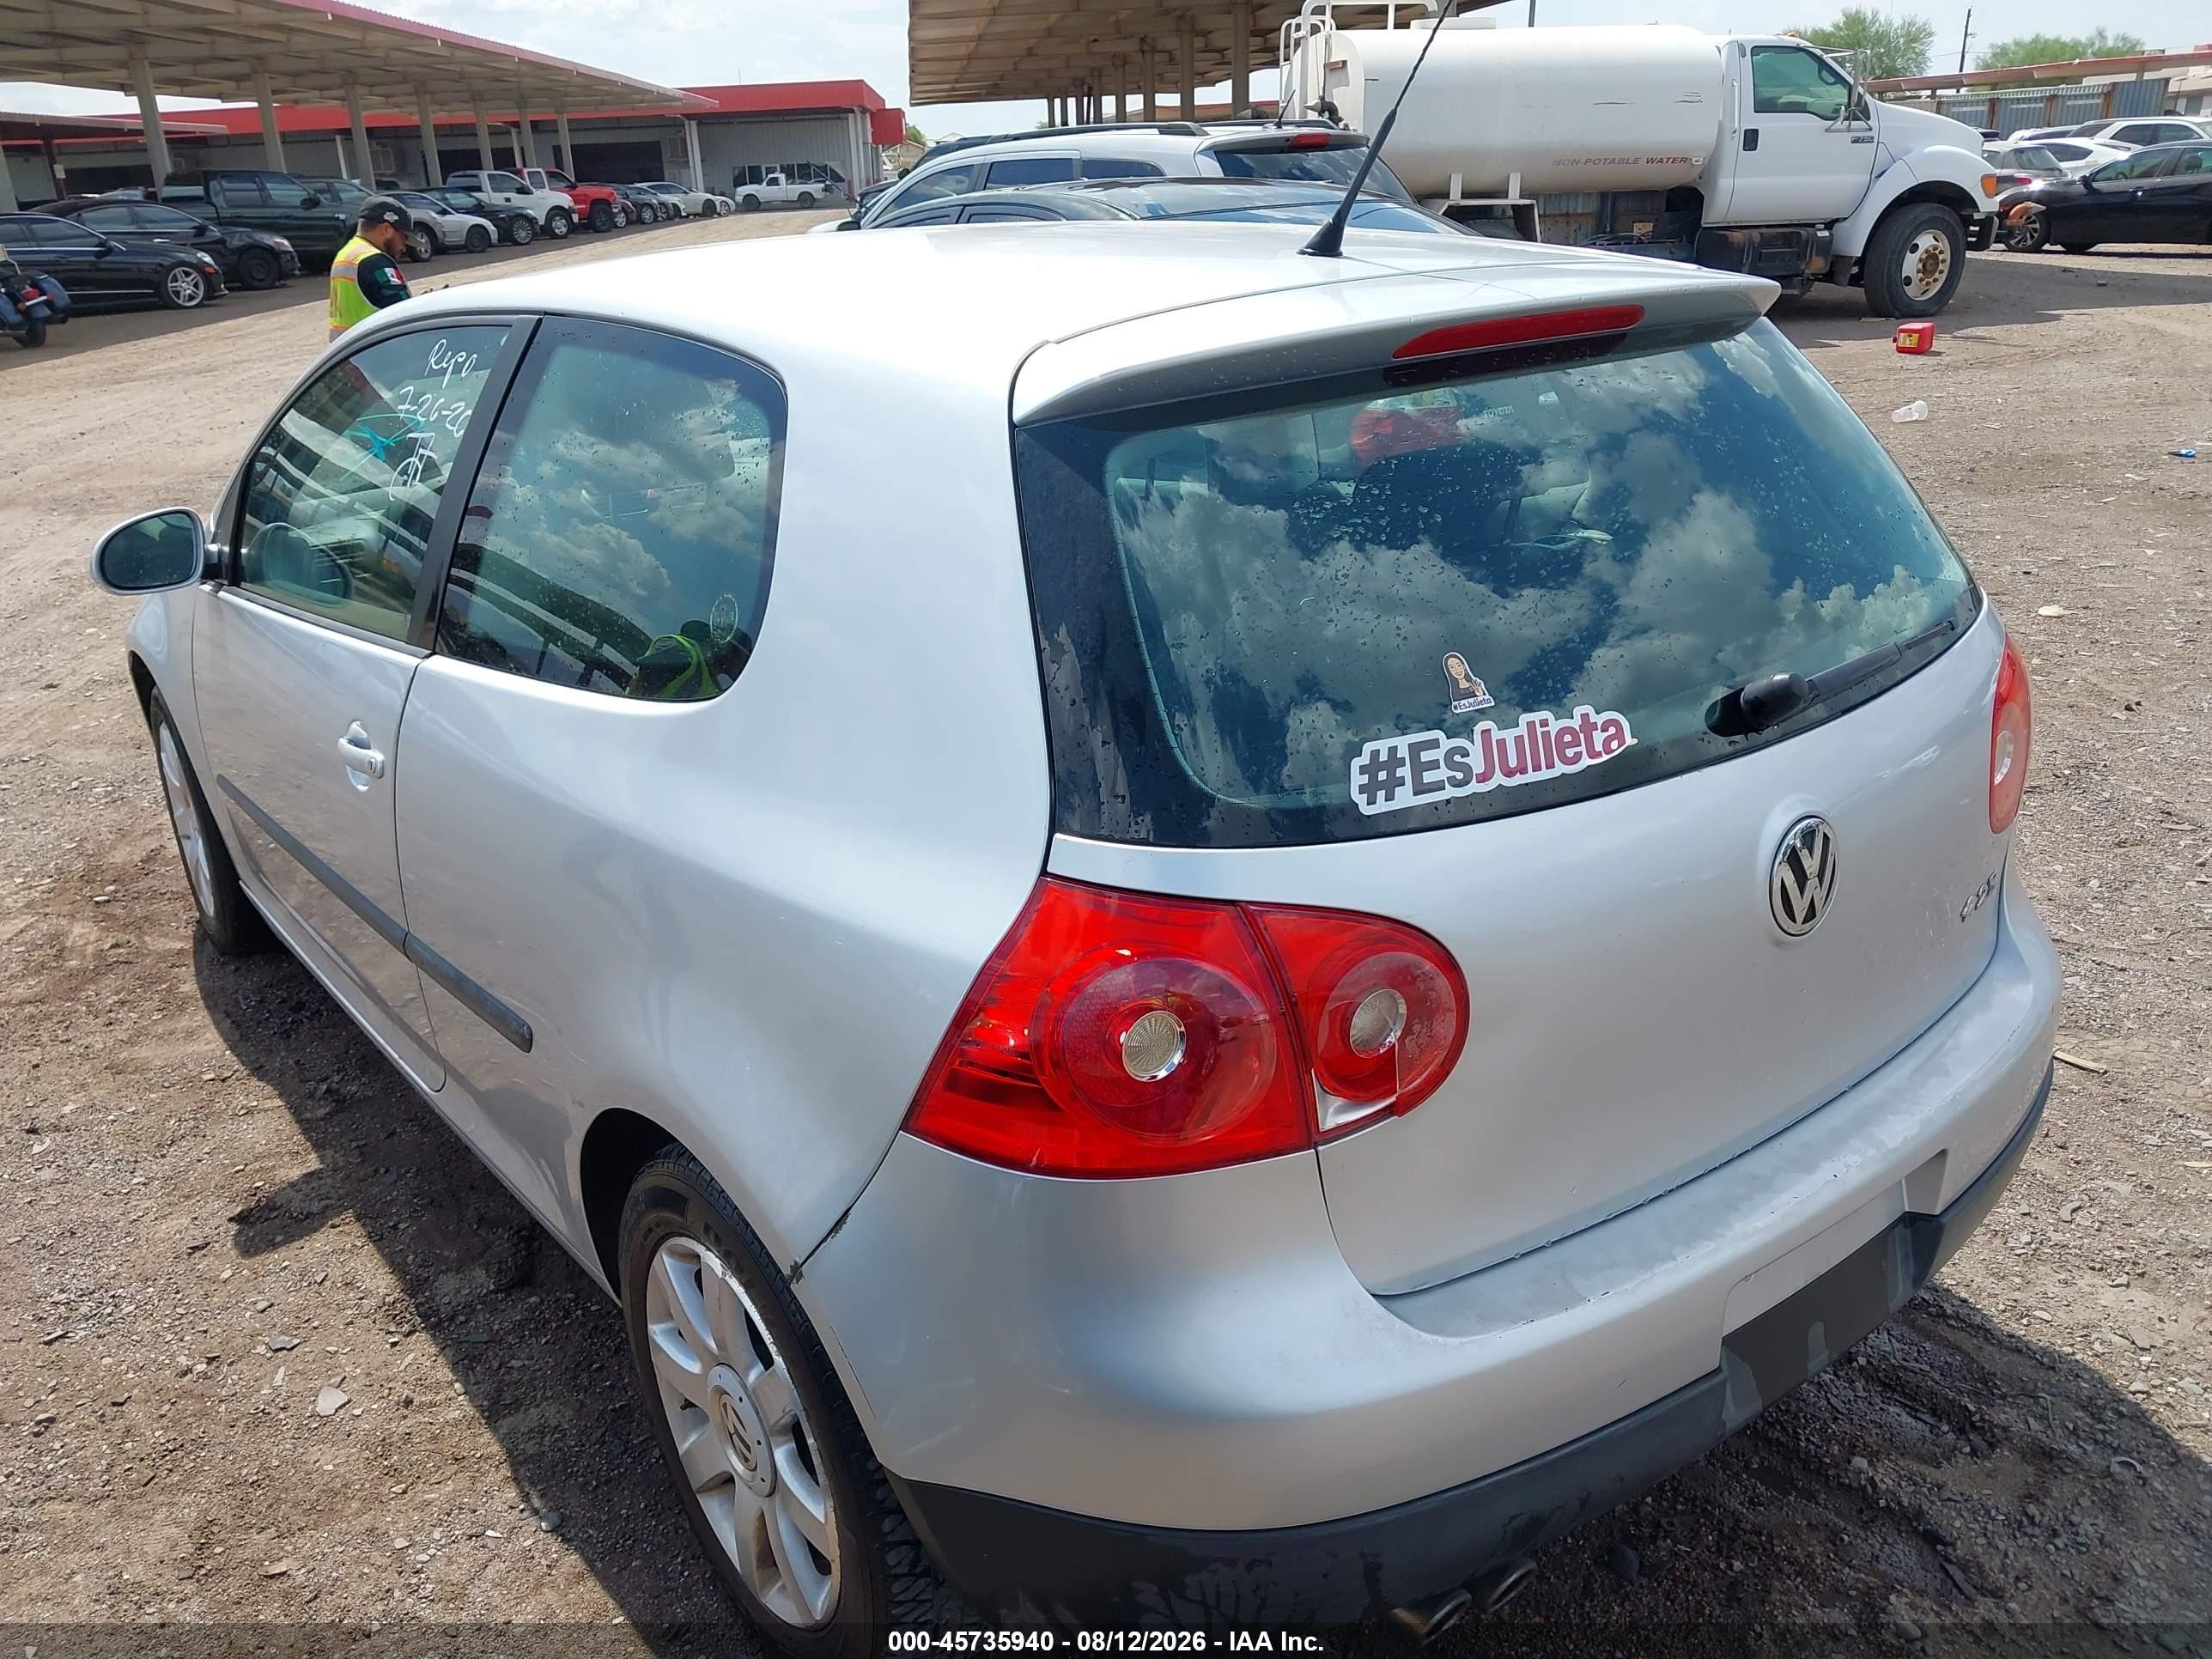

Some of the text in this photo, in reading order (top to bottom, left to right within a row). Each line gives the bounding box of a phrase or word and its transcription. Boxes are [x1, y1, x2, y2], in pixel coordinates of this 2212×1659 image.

[424, 338, 477, 390] Repo
[1453, 697, 1492, 711] #EsJulieta
[1358, 712, 1626, 806] #EsJulieta
